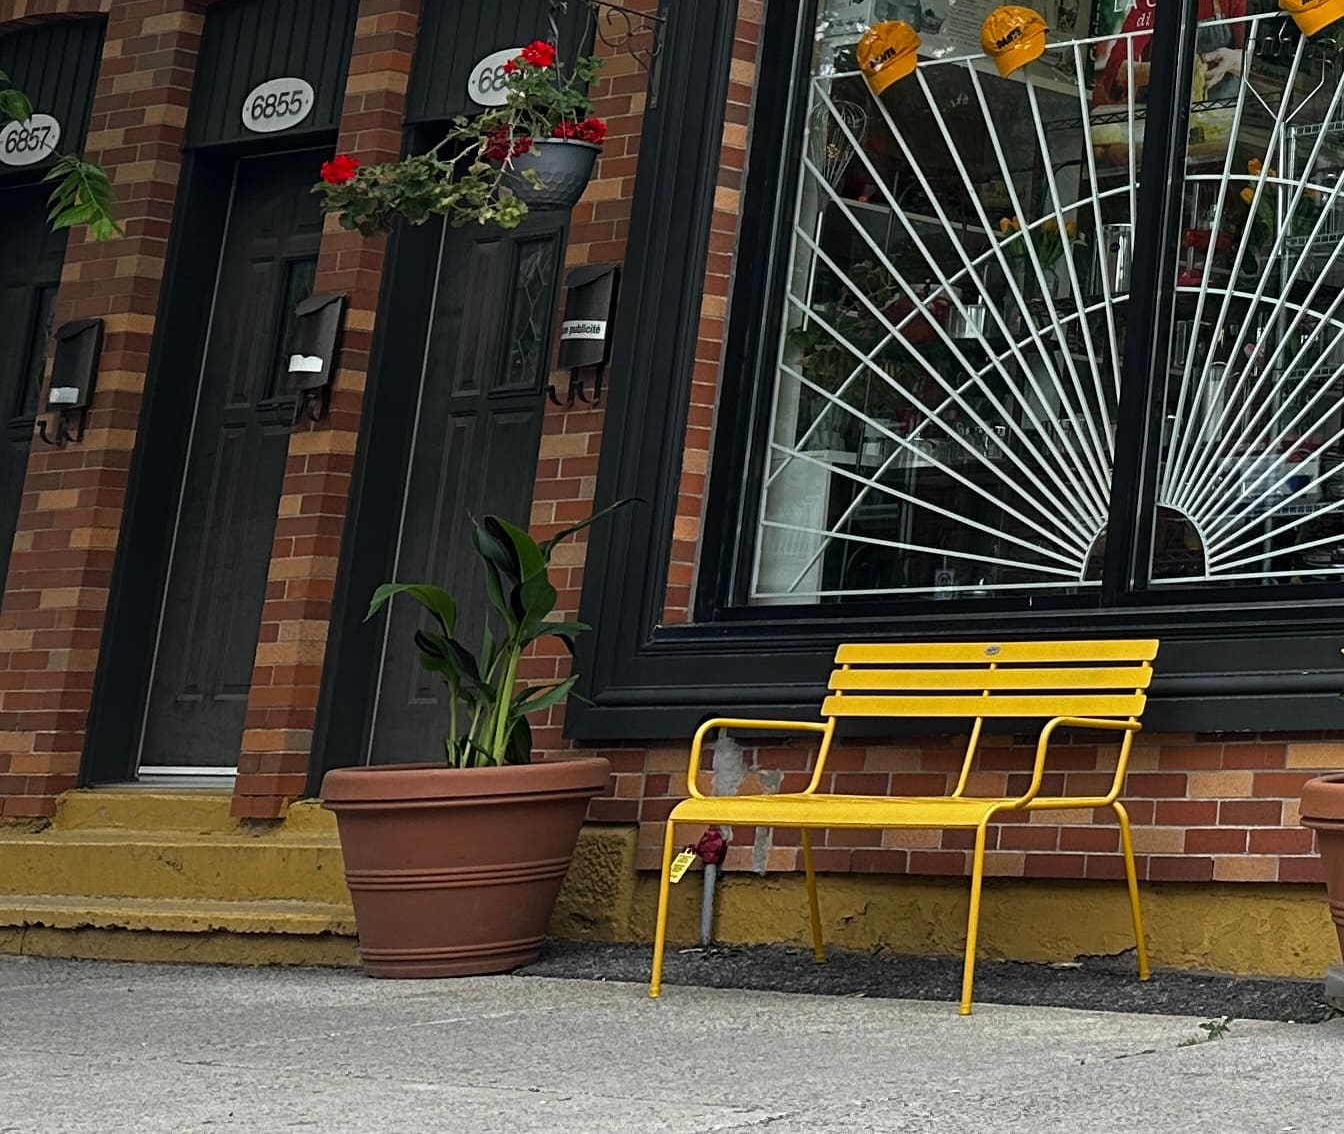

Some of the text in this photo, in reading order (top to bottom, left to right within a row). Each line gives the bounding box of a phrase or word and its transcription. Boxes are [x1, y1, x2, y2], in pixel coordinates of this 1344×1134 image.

[1136, 11, 1151, 28] di
[250, 90, 303, 121] 6855
[5, 126, 51, 154] 6857
